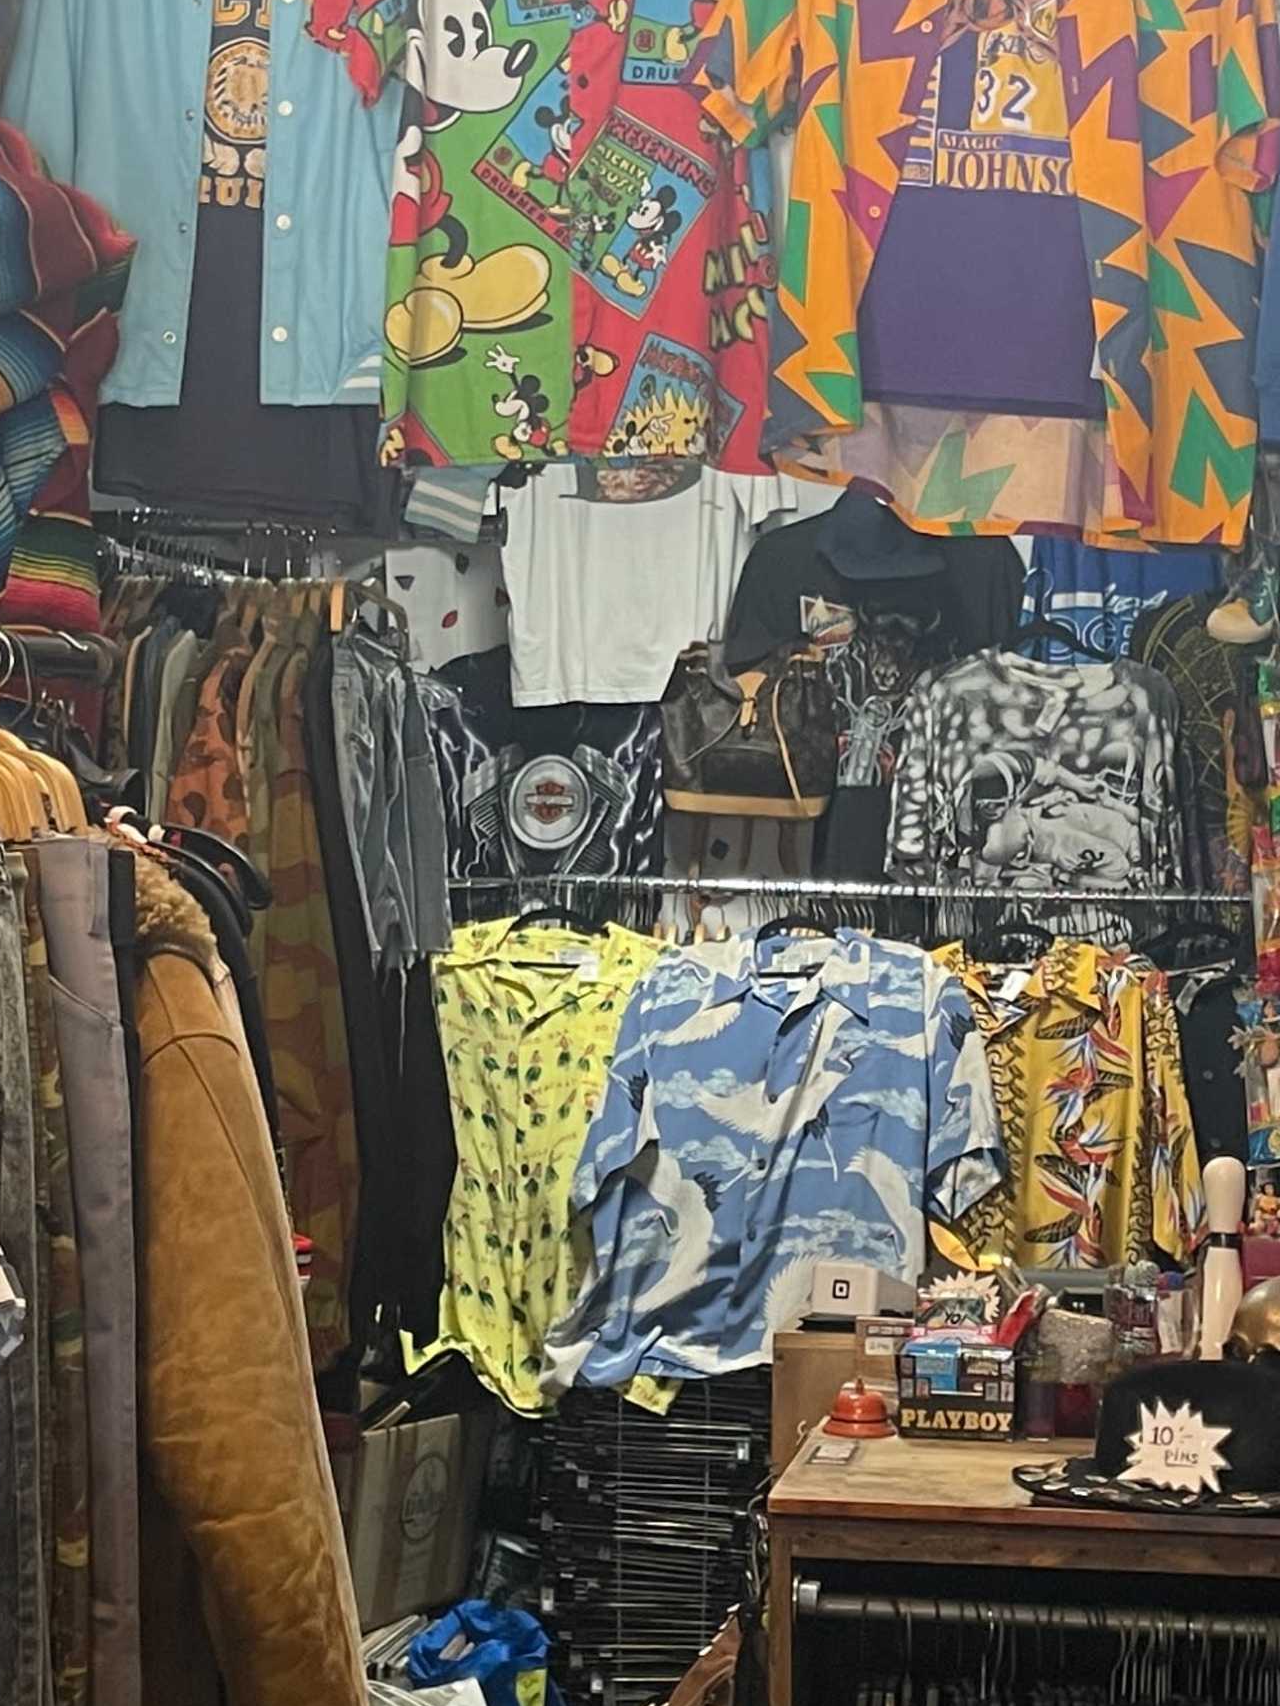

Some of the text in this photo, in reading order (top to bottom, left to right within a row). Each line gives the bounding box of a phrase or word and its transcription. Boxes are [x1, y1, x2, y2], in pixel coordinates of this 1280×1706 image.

[977, 69, 1032, 122] 32
[943, 134, 1004, 150] MAGIC
[901, 1408, 1013, 1432] PLAYBOY
